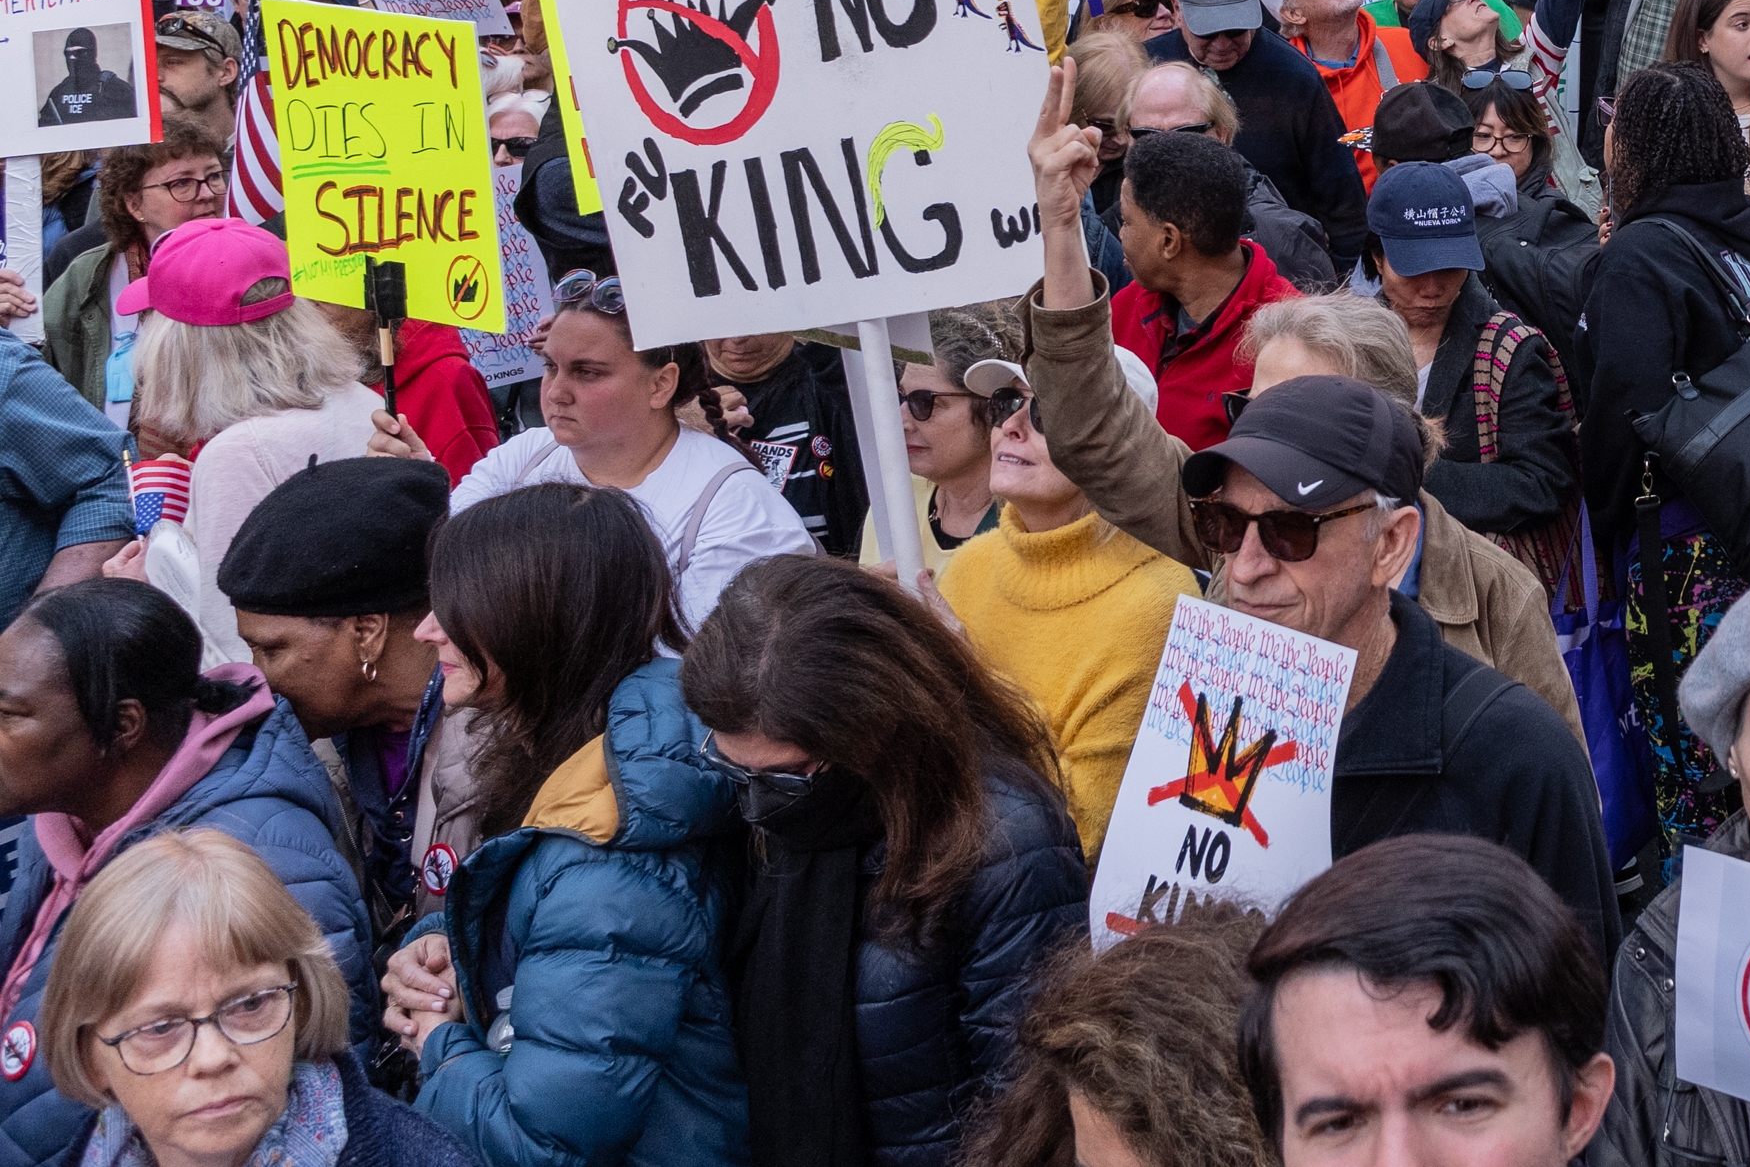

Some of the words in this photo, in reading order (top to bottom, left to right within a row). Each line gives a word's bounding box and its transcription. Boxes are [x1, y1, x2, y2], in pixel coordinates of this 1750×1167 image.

[278, 18, 457, 91] DEMOCRACY
[62, 94, 92, 103] POLICE
[70, 105, 83, 114] ICE
[287, 98, 387, 161] DIES
[412, 101, 466, 153] IN
[316, 180, 479, 255] SILENCE
[669, 115, 963, 298] KING
[1403, 205, 1465, 220] 横山帽子公司
[1174, 824, 1231, 885] NO
